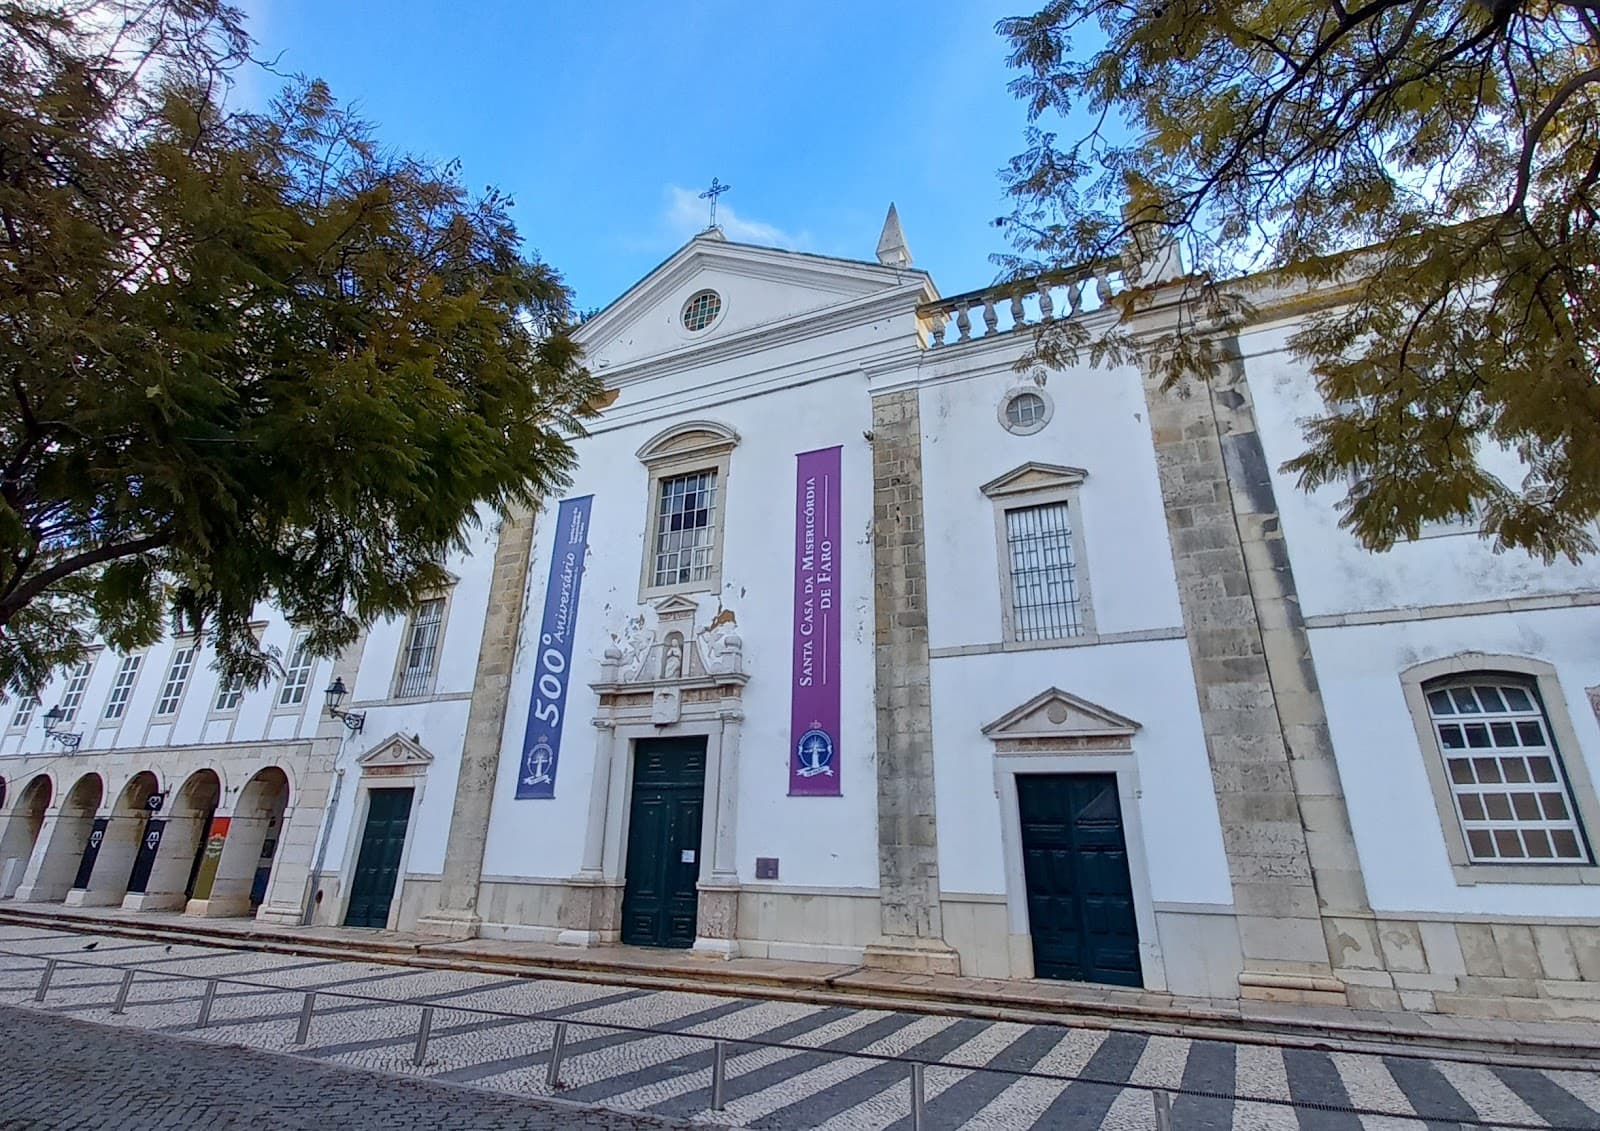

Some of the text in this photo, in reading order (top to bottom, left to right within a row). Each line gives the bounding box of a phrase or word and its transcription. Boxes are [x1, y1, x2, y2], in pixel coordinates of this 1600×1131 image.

[553, 552, 576, 643] Aniversário
[799, 476, 816, 686] SANTA CASA DA MISERICÓRDIA
[817, 540, 832, 610] DE FARO
